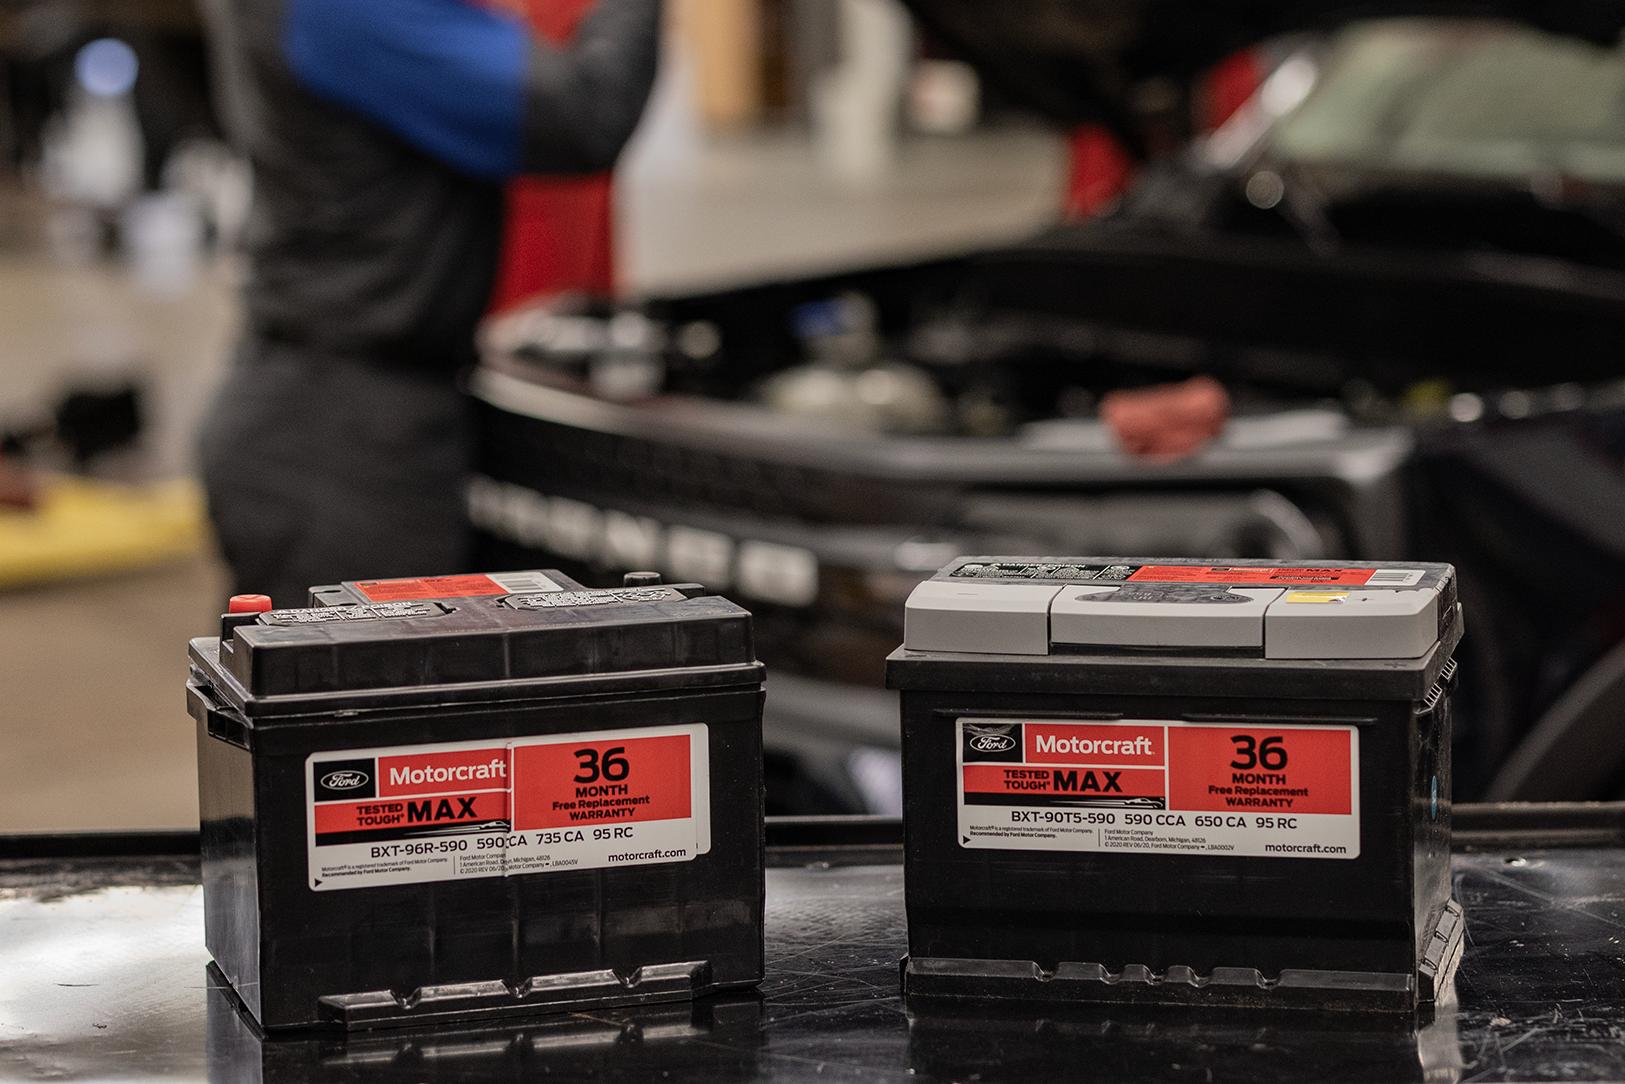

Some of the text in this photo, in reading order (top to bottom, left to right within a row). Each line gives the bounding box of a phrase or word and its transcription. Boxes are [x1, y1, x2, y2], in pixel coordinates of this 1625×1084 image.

[978, 736, 1007, 749] Ford
[1036, 736, 1152, 755] Motorcraft
[1230, 735, 1288, 770] 36
[574, 747, 629, 783] 36
[390, 759, 506, 785] Motorcraft
[1004, 770, 1049, 779] TESTED
[329, 773, 360, 787] Ford
[1054, 771, 1122, 792] MAX
[1232, 774, 1286, 784] MONTH
[576, 785, 628, 798] MONTH
[1209, 785, 1308, 796] Free Replacement
[552, 796, 649, 810] Free Replacement
[1226, 797, 1293, 808] WARRANTY
[357, 804, 403, 815] TESTED
[408, 797, 477, 822] MAX
[570, 808, 635, 820] WARRANTY
[1012, 811, 1297, 829] BXT-90T5-590 590 CCA 650 CA 95 RC
[371, 840, 467, 858] BXT-96R-590
[478, 837, 504, 849] 590
[536, 832, 561, 844] 735
[565, 831, 584, 842] CA
[593, 829, 610, 840] 95
[614, 827, 633, 838] RC
[1265, 844, 1346, 854] motorcraft.com
[608, 849, 686, 862] motorcraft.com
